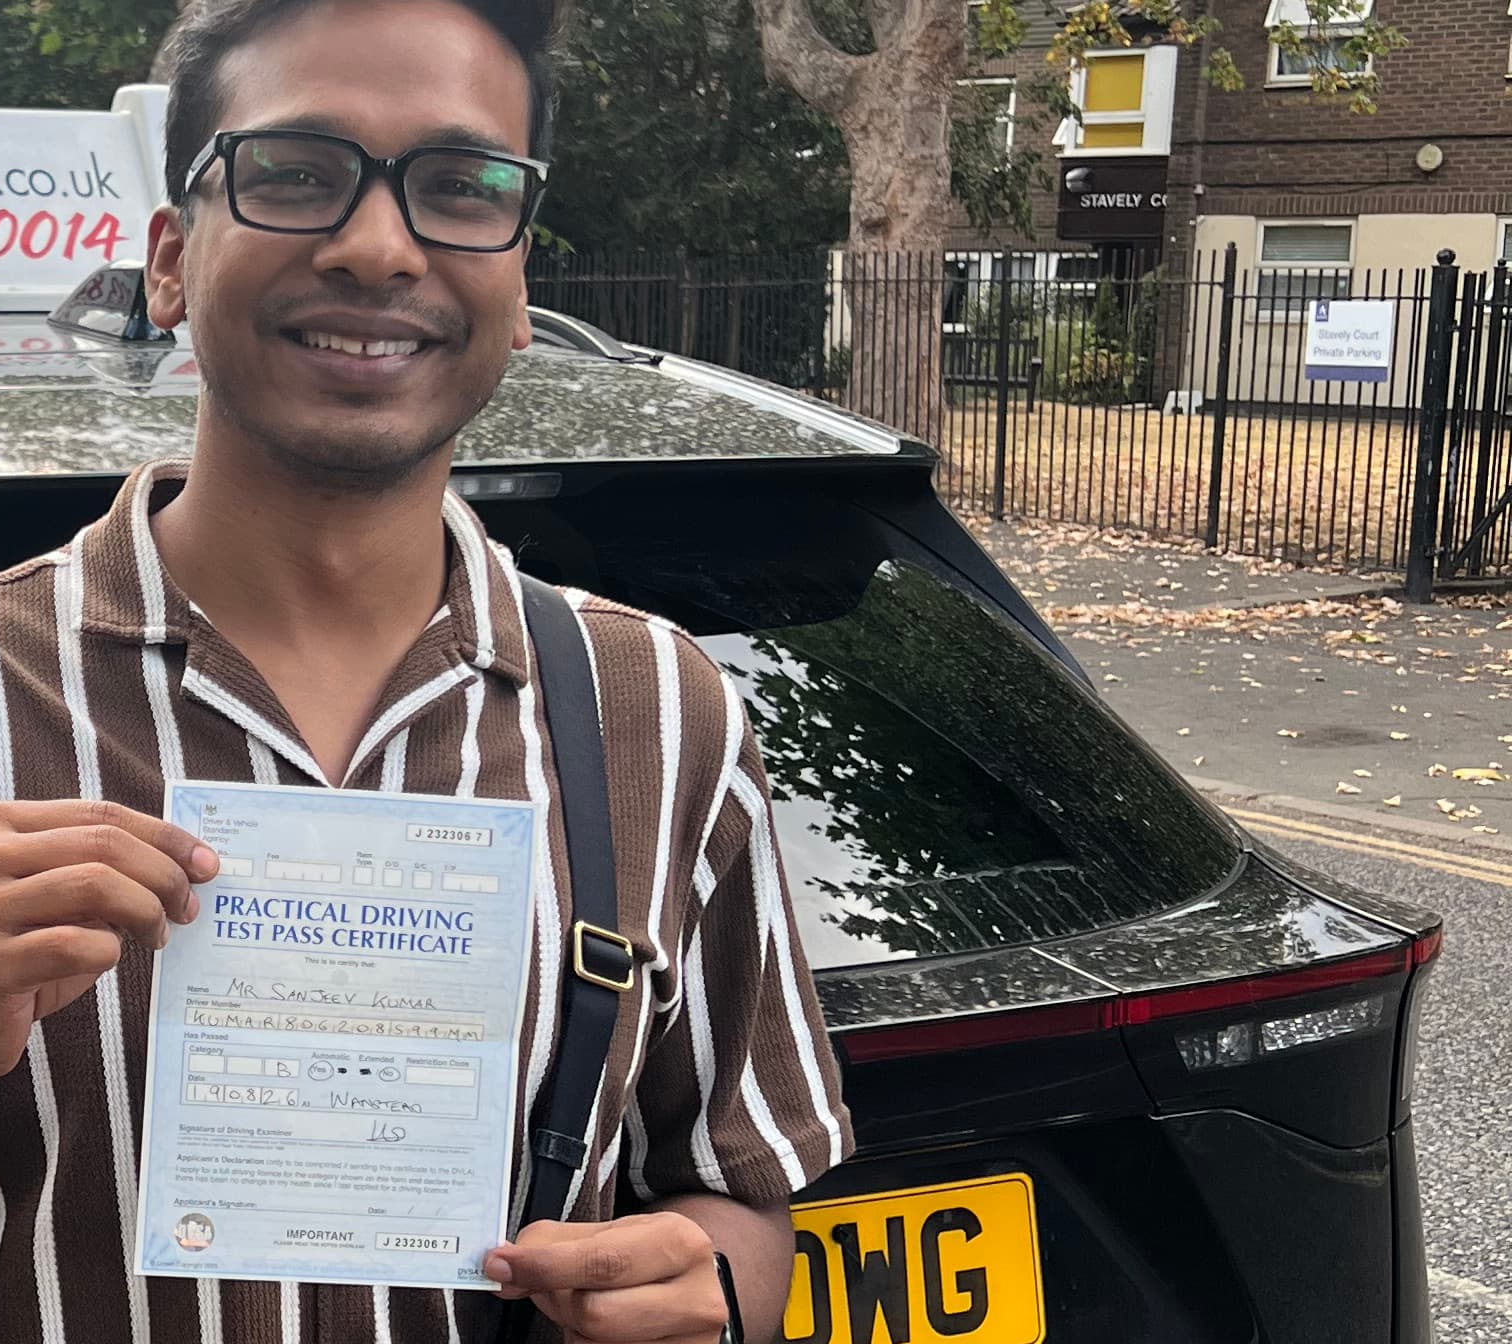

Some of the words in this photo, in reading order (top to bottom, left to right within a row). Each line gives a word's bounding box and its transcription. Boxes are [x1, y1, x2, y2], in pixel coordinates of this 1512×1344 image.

[1080, 193, 1143, 208] STAVELY
[1318, 328, 1350, 342] Stavely
[1353, 329, 1379, 340] Court
[1313, 346, 1345, 357] Private
[1347, 347, 1382, 360] Parking
[416, 828, 422, 838] J
[427, 829, 471, 842] 232306
[476, 832, 483, 842] 7
[215, 895, 351, 923] PRACTICAL
[361, 905, 474, 932] DRIVING
[214, 920, 264, 941] TEST
[272, 923, 324, 945] PASS
[331, 928, 473, 955] CERTIFICATE
[187, 985, 209, 993] Name
[271, 982, 357, 1005] SANJEEV
[372, 990, 438, 1010] KUMAR
[186, 998, 209, 1006] Driver
[211, 999, 241, 1008] Number
[201, 1032, 229, 1040] Passed
[189, 1044, 224, 1056] Category
[312, 1051, 351, 1061] Automatic
[359, 1054, 395, 1064] Extended
[406, 1056, 448, 1067] Restriction
[449, 1059, 470, 1067] Code
[277, 1061, 291, 1077] B
[313, 1065, 327, 1073] Yes
[226, 1126, 255, 1136] Driving
[256, 1127, 292, 1136] Examiner
[221, 1156, 265, 1165] Declaration
[286, 1229, 354, 1241] IMPORTANT
[383, 1237, 390, 1247] J
[395, 1237, 438, 1249] 232306
[443, 1240, 449, 1249] 7
